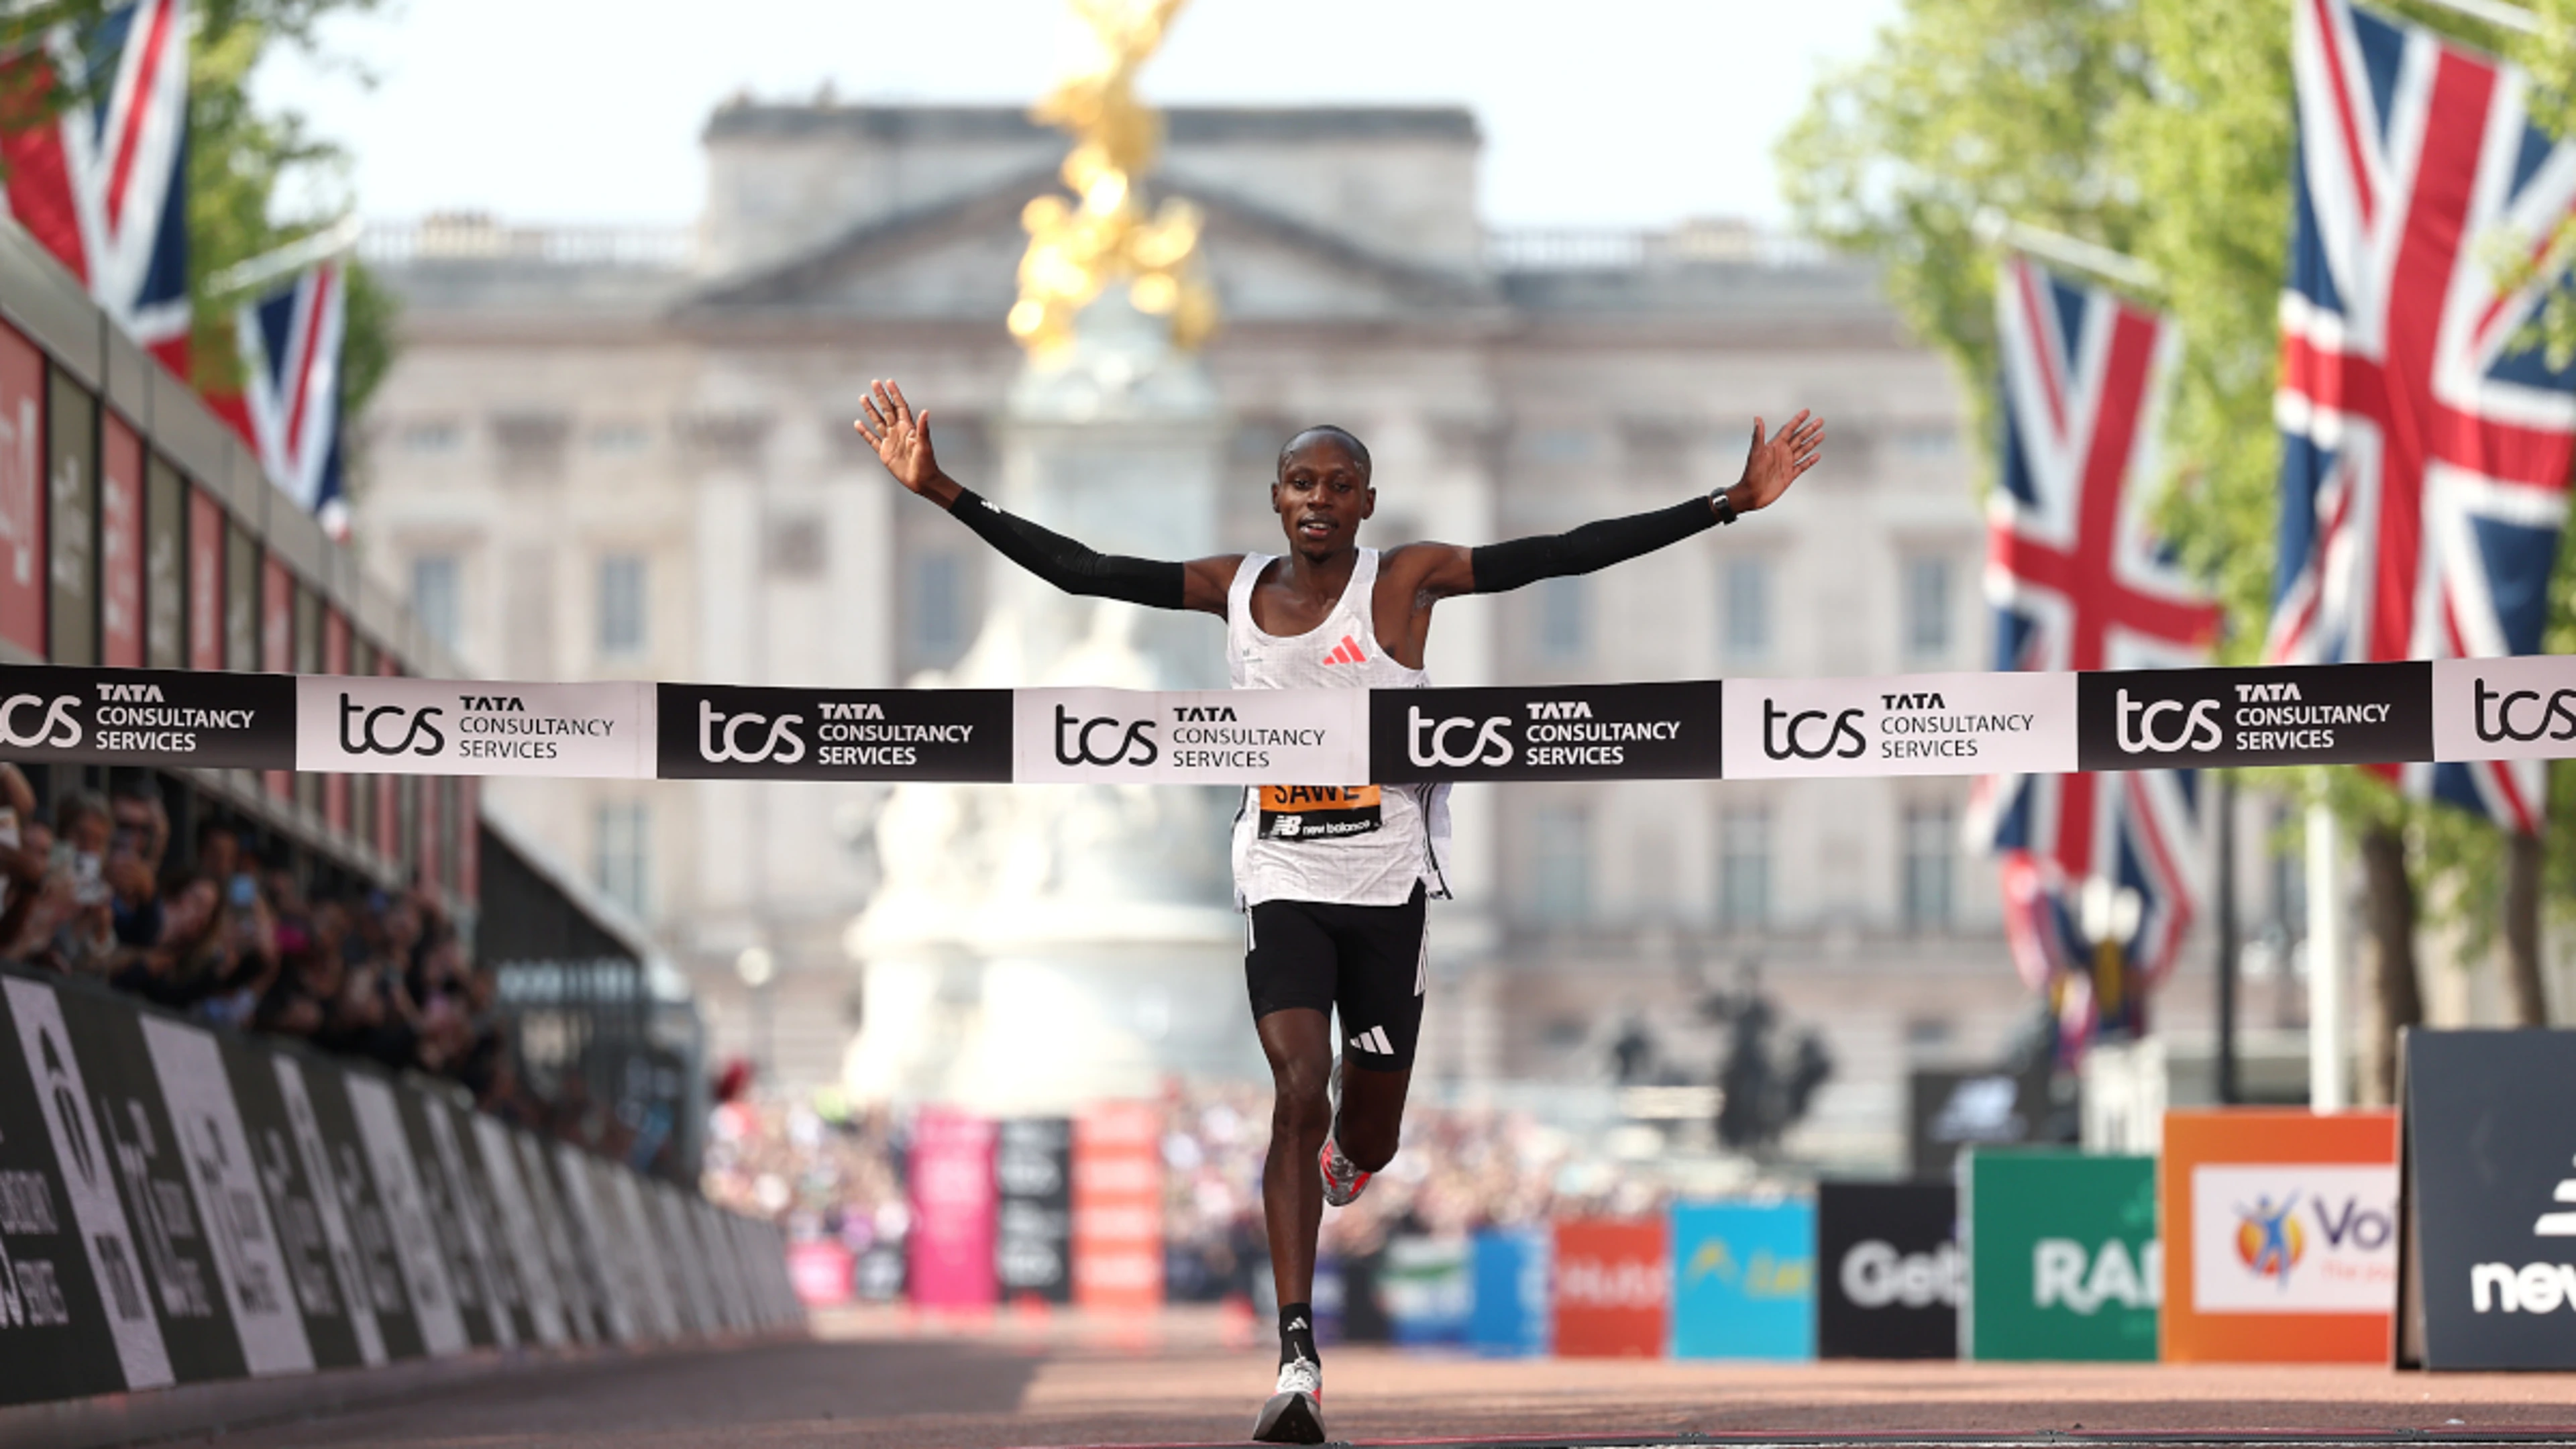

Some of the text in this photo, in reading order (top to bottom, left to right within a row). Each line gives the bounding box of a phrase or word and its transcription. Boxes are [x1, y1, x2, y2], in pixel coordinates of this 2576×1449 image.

[96, 683, 165, 703] TATA
[1880, 692, 1946, 711] TATA
[2235, 682, 2302, 703] TATA
[459, 695, 525, 712] TATA
[818, 702, 885, 720] TATA
[1173, 706, 1238, 722] TATA
[1525, 701, 1593, 720] TATA
[2474, 678, 2576, 743] tcs
[0, 694, 83, 749] cs
[96, 706, 255, 729] CONSULTANCY
[339, 692, 445, 757] tcs
[1880, 714, 2034, 735] CONSULTANCY
[2116, 688, 2222, 754] tcs
[2235, 703, 2391, 727] CONSULTANCY
[459, 716, 614, 737] CONSULTANCY
[699, 699, 806, 764] tcs
[818, 724, 973, 743] CONSULTANCY
[1055, 703, 1159, 767] tcs
[1173, 727, 1326, 746] CONSULTANCY
[1408, 705, 1514, 767] tcs
[1525, 720, 1680, 743] CONSULTANCY
[1764, 698, 1866, 761] tcs
[95, 730, 197, 752] SERVICES
[459, 739, 557, 759] SERVICES
[1880, 739, 1978, 759] SERVICES
[2235, 729, 2334, 751] SERVICES
[818, 746, 917, 765] SERVICES
[1173, 749, 1270, 768] SERVICES
[1525, 745, 1624, 766] SERVICES
[1303, 825, 1325, 835] new
[2312, 1196, 2398, 1252] Vo
